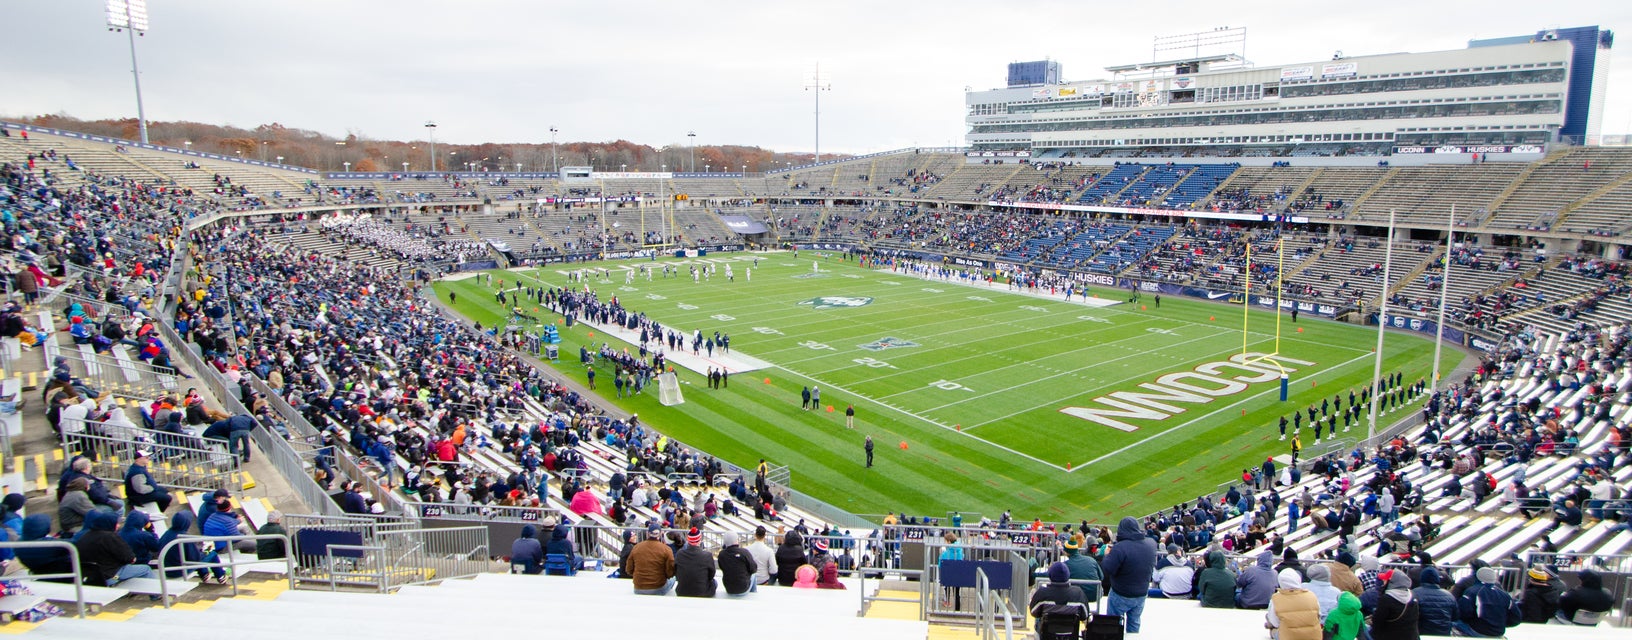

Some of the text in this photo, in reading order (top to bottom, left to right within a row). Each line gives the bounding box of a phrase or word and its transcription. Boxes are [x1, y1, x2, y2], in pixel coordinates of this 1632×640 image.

[1074, 272, 1114, 285] HUSKIES
[798, 340, 829, 350] 30
[852, 357, 889, 368] 20
[928, 379, 962, 390] 10
[1058, 352, 1318, 433] UCONN
[426, 507, 440, 515] 230
[522, 512, 537, 520] 231
[908, 531, 922, 539] 231
[1013, 535, 1029, 543] 232
[1554, 559, 1571, 567] 232
